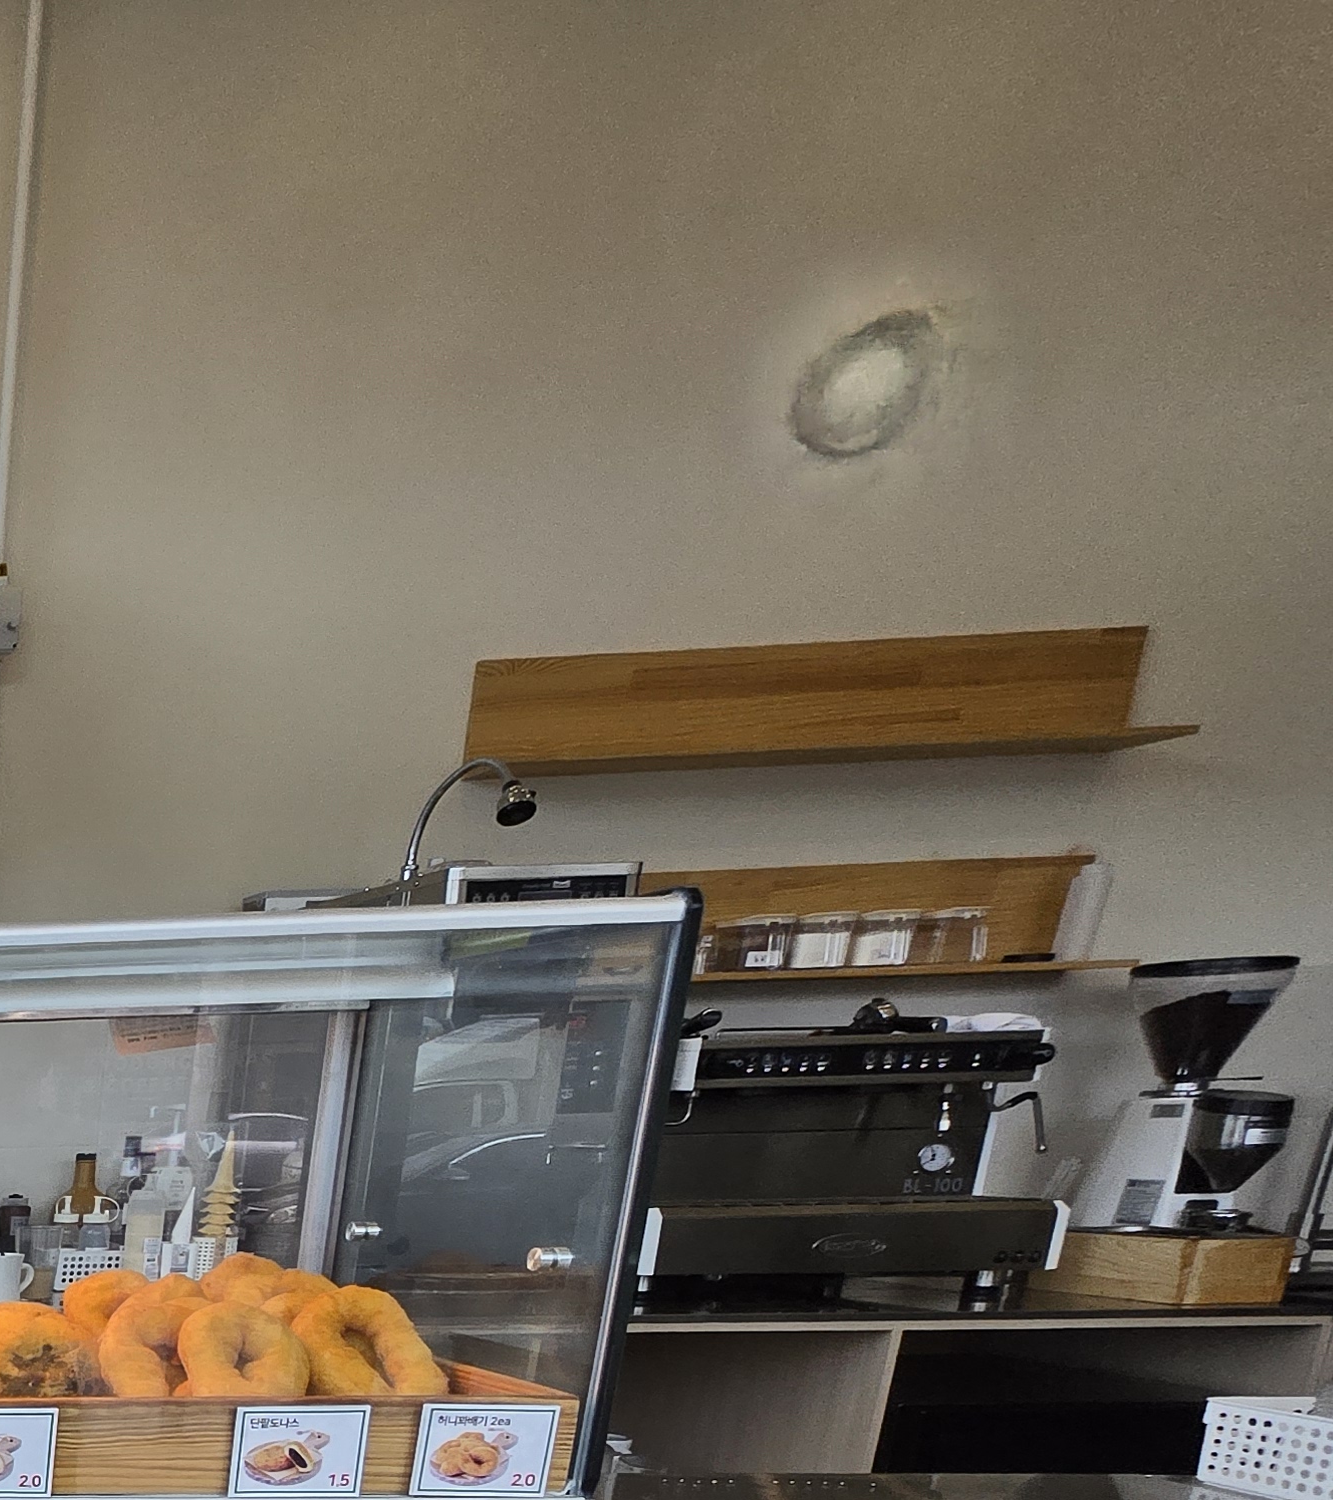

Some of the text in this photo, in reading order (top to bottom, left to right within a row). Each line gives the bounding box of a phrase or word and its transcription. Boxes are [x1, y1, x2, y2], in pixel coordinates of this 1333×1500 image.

[902, 1178, 963, 1194] BL-100
[438, 1415, 511, 1427] 허니꽈배기 2ea
[18, 1475, 42, 1489] 2.0
[328, 1473, 350, 1487] 1.5
[511, 1473, 536, 1487] 2.0
